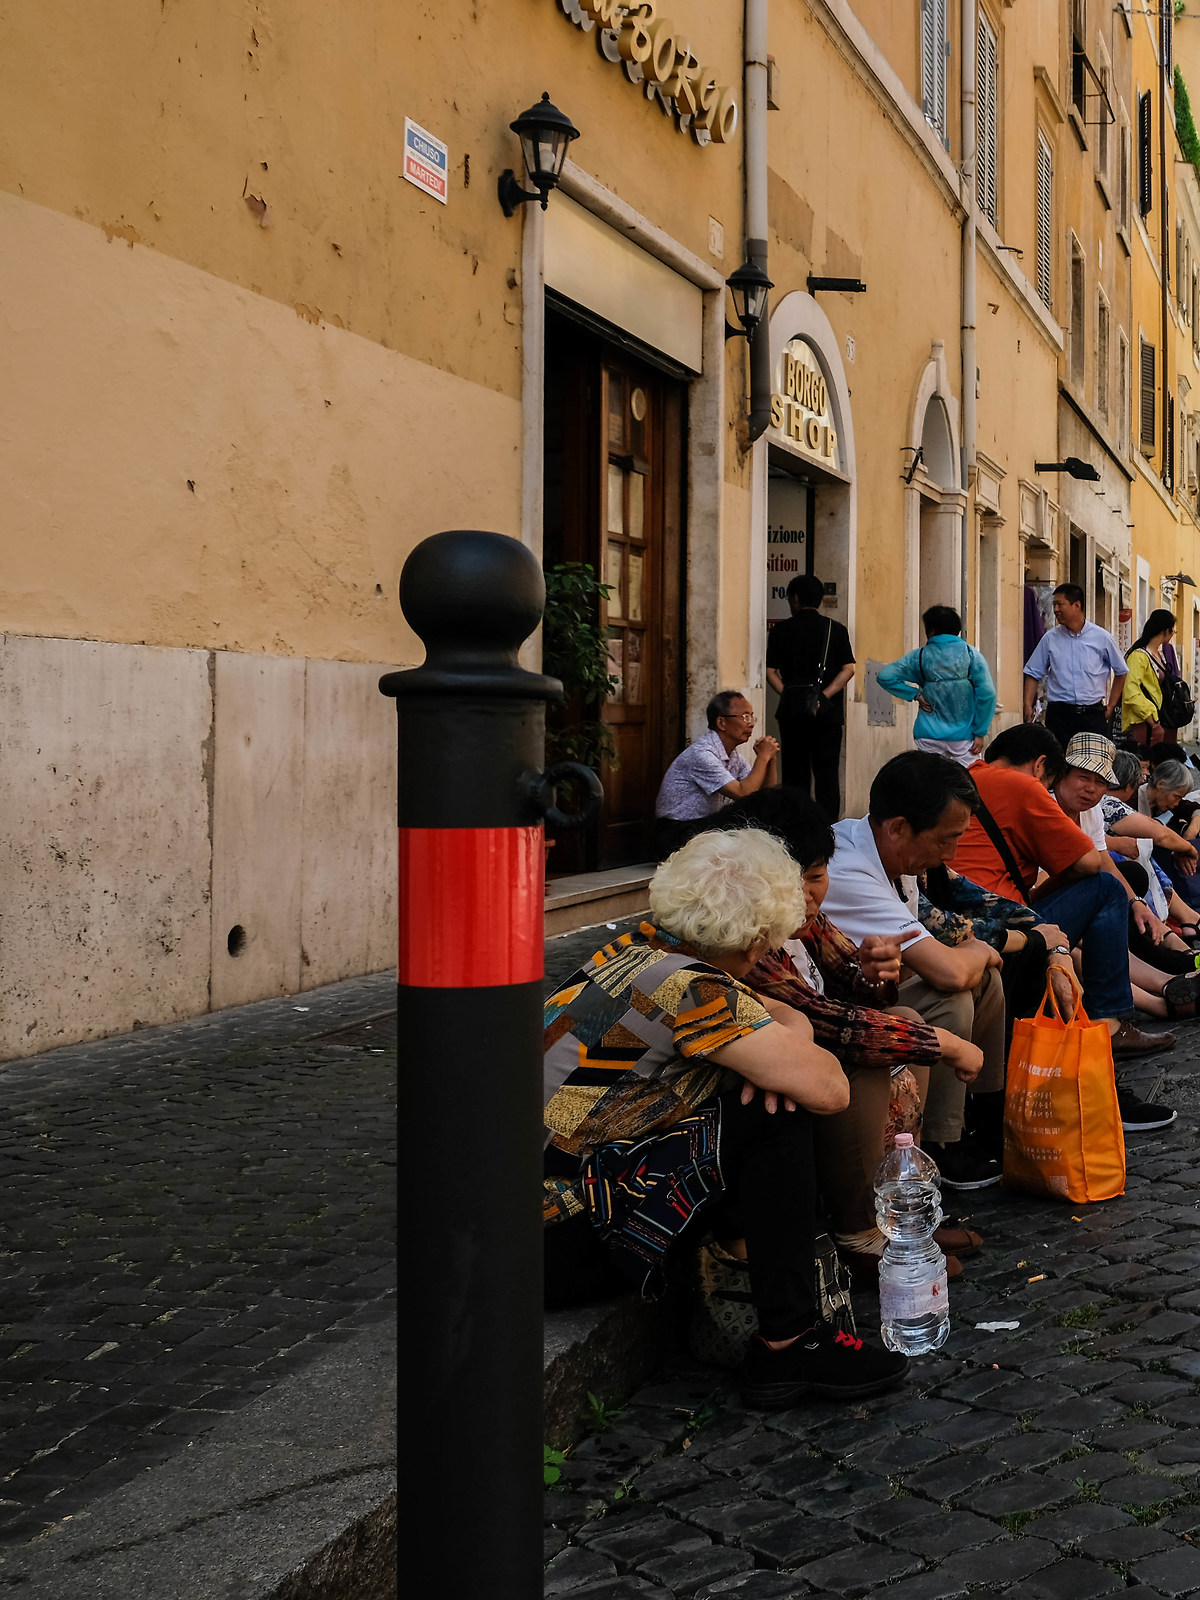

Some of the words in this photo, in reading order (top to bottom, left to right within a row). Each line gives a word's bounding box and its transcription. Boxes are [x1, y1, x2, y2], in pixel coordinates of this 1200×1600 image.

[413, 136, 440, 163] CHIUSO
[783, 353, 828, 417] BORGO
[771, 394, 837, 457] SHOP
